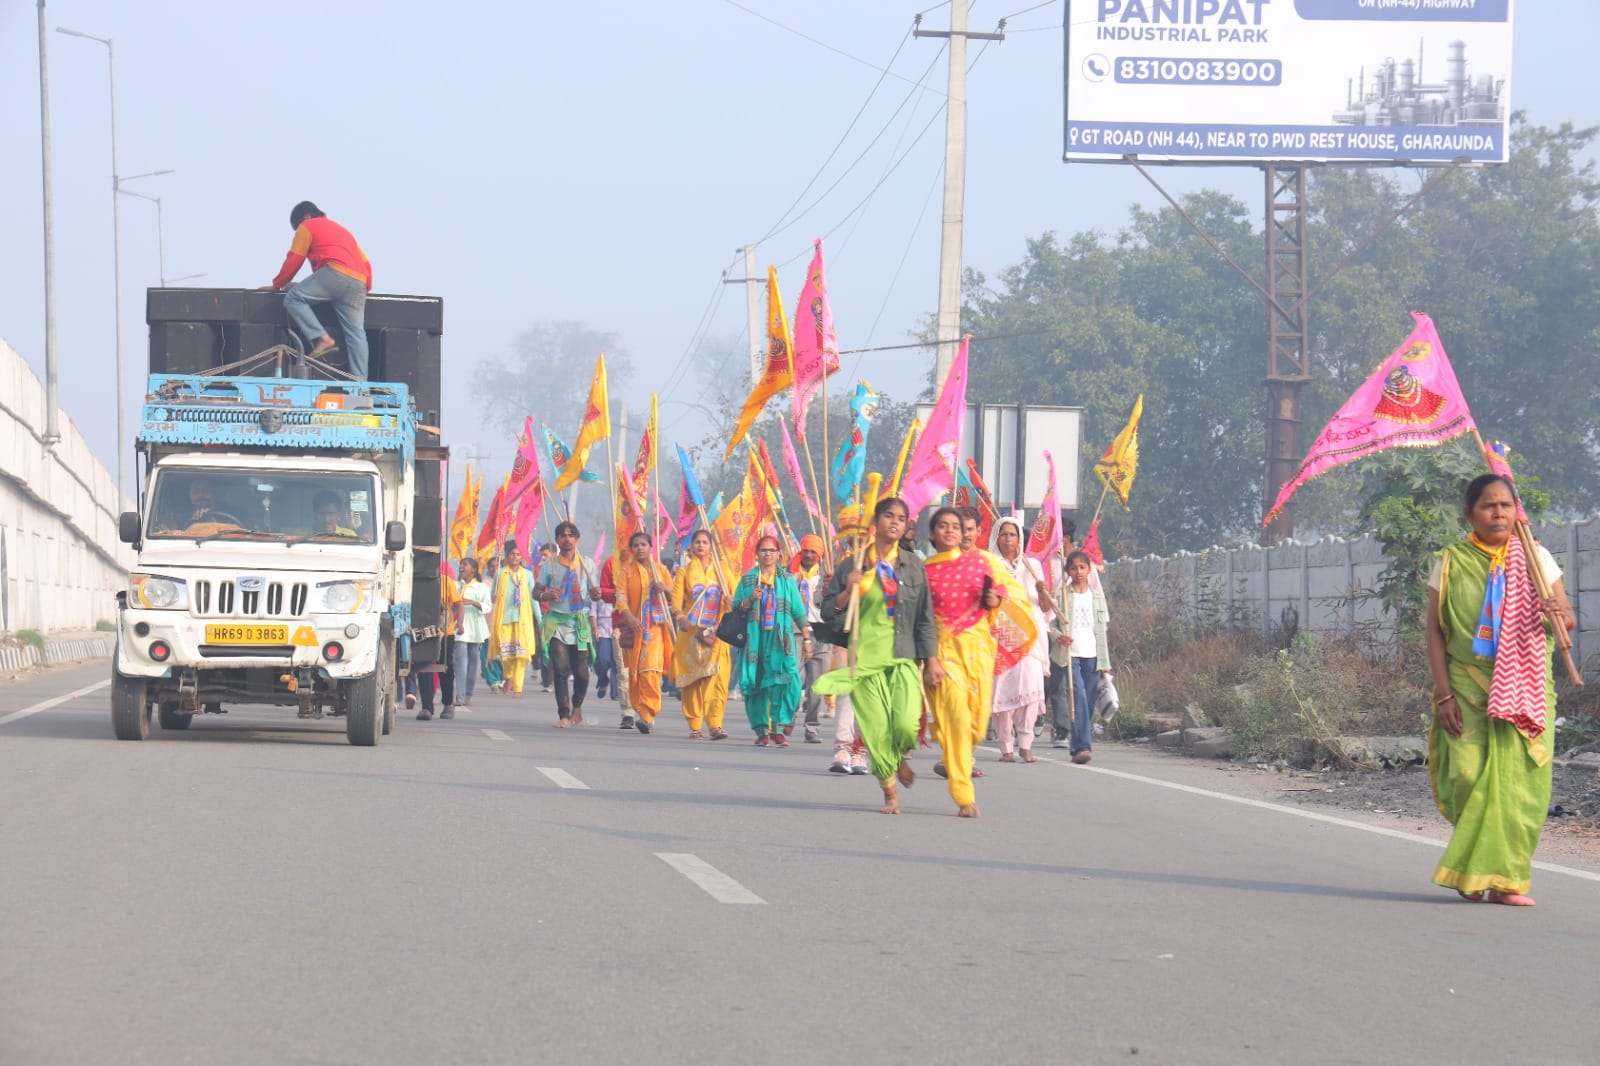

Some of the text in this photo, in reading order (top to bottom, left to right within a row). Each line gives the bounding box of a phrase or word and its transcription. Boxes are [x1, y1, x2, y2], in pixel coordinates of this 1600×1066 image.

[1097, 0, 1271, 26] PANIPAT
[1358, 0, 1476, 9] ON (NH-44) HIGHWAY
[1097, 26, 1269, 43] INDUSTRIAL PARK
[1120, 60, 1276, 82] 8310083900
[1081, 129, 1495, 152] GT ROAD (NH 44), NEAR TO PWD REST HOUSE, GHARAUNDA
[214, 628, 243, 640] HR69
[256, 628, 285, 640] 3863
